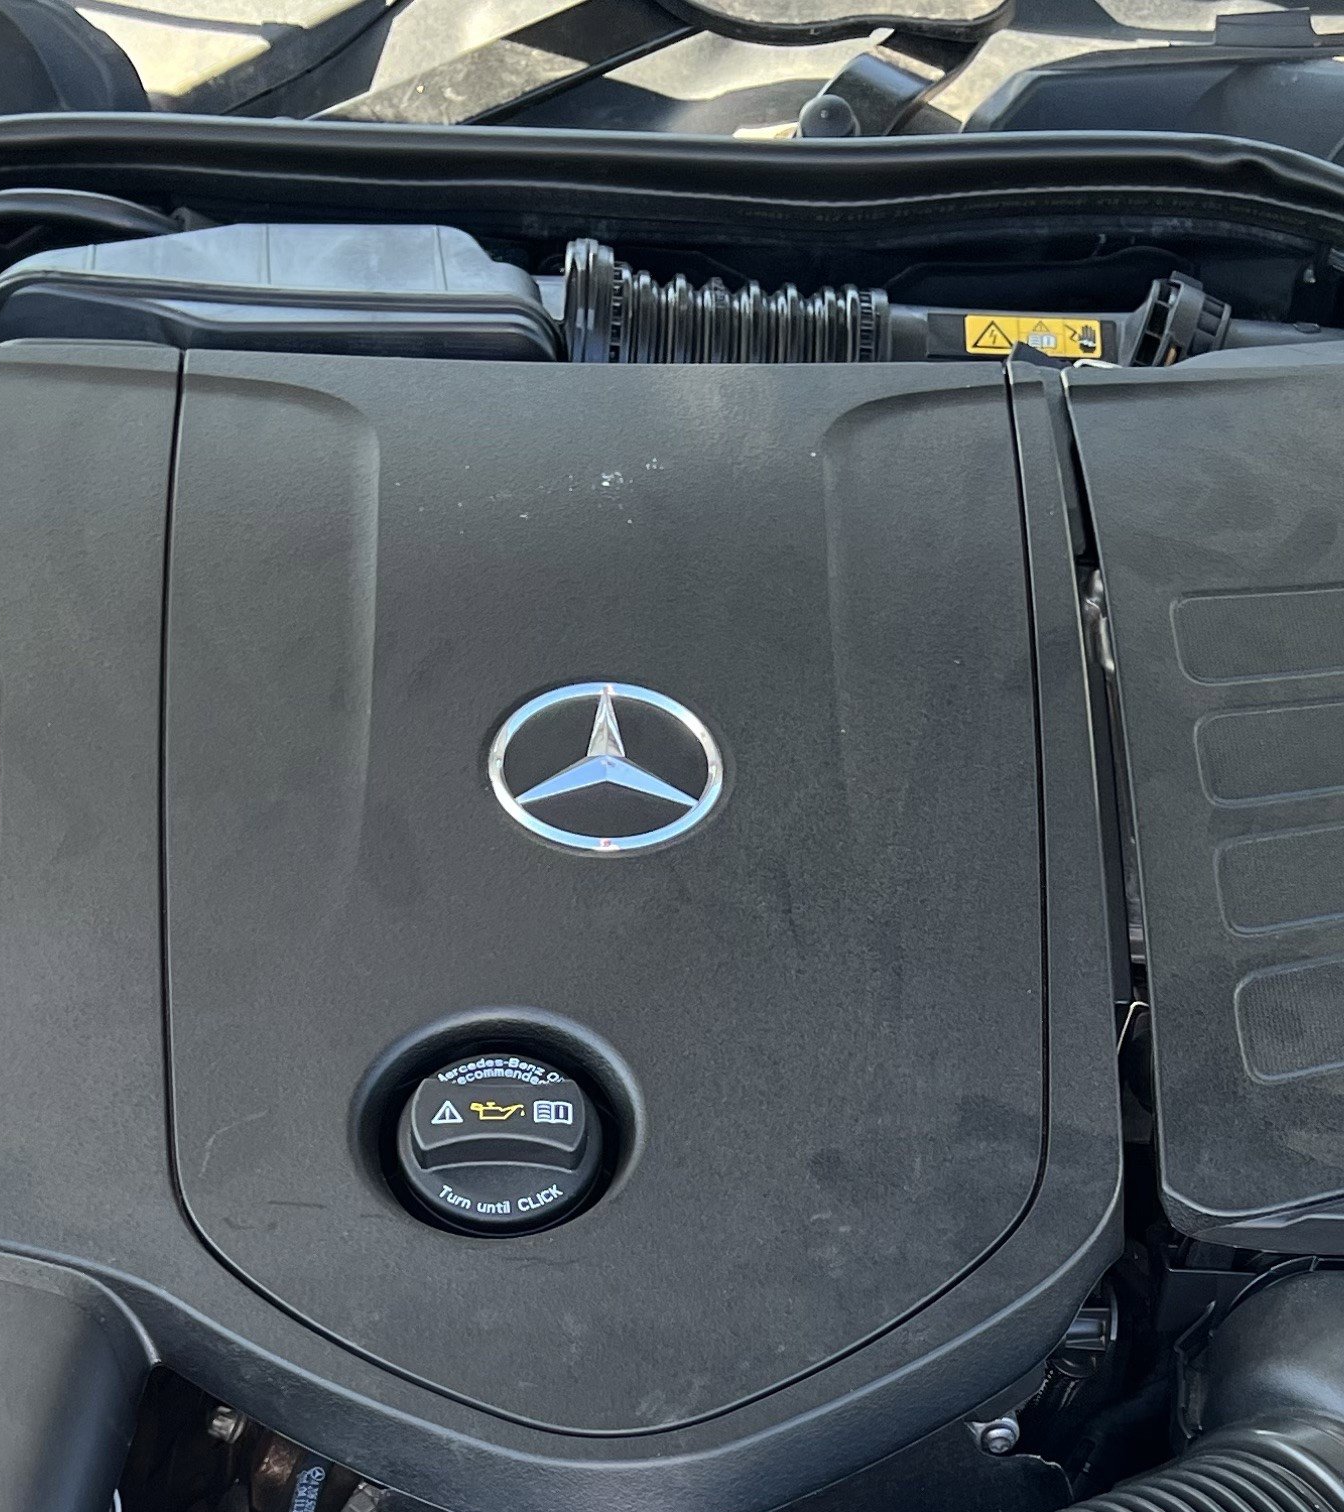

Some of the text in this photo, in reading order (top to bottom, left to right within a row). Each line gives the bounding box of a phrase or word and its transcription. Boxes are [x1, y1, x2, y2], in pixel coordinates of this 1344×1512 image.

[438, 1183, 564, 1214] Turn until CLICK
